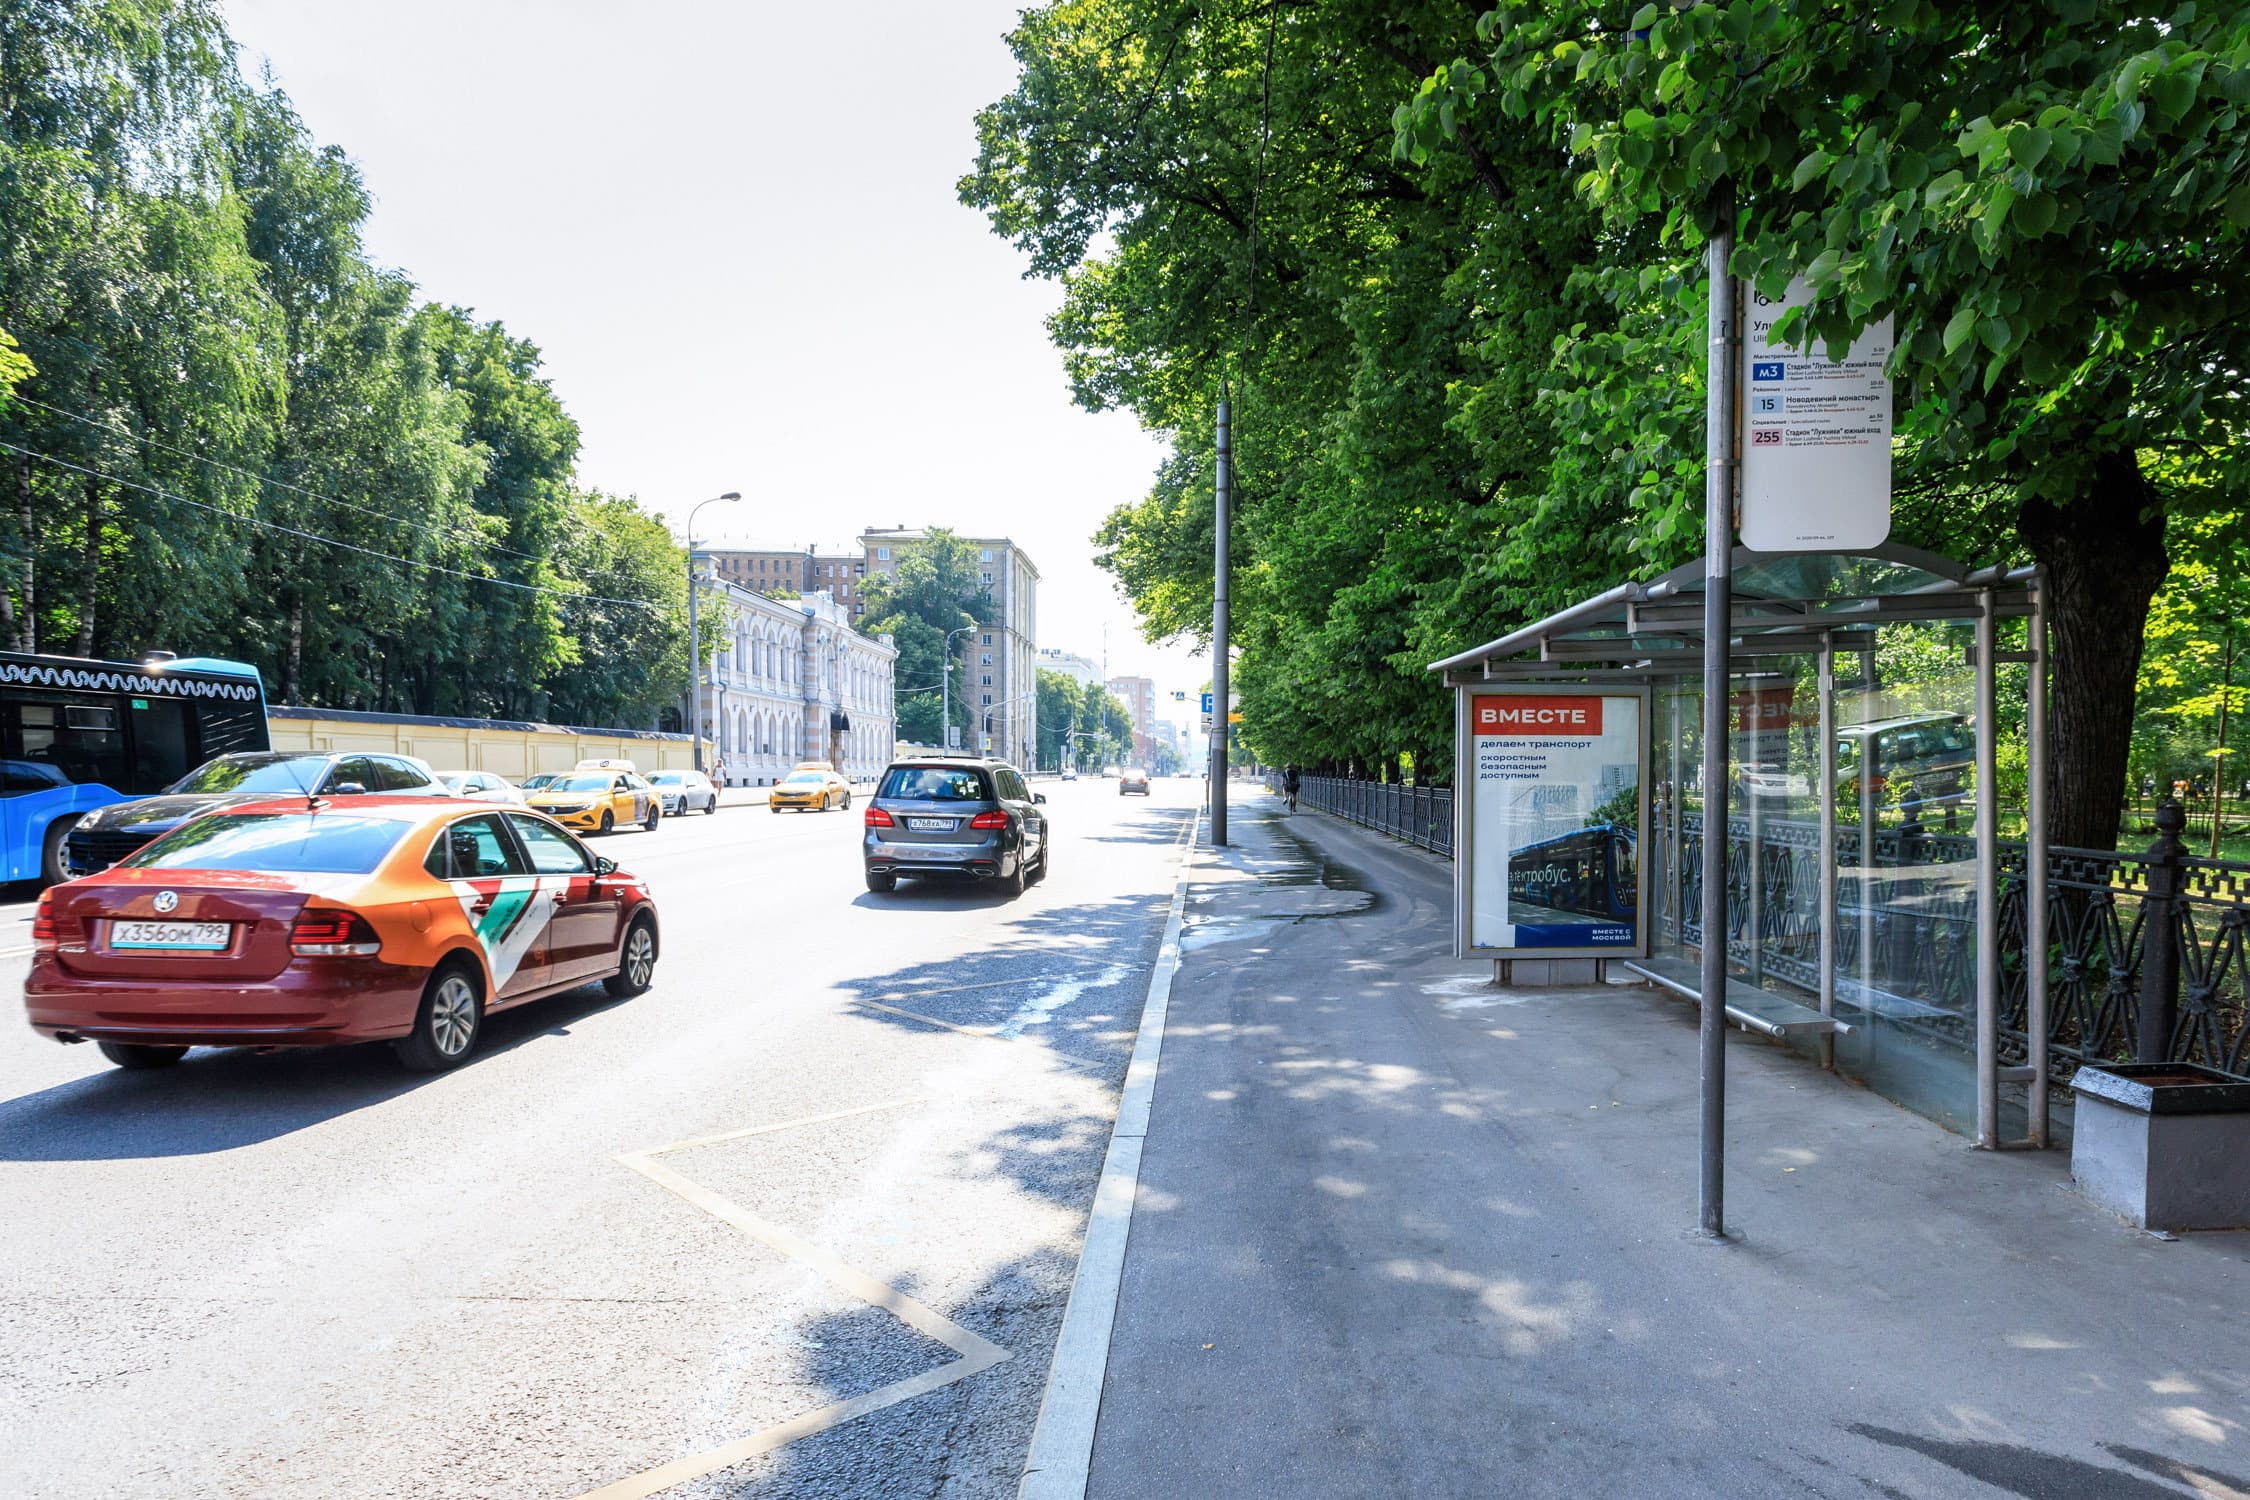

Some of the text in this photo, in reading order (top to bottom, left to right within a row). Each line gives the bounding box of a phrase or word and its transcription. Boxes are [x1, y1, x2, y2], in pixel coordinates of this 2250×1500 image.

[1786, 394, 1880, 404] Новодевичий монастырь
[1761, 399, 1775, 410] 15
[1755, 431, 1780, 443] 255
[1785, 429, 1810, 437] Стадион
[1481, 709, 1586, 723] ВМЕСТЕ
[1481, 741, 1592, 750] делаем транспорт
[1480, 755, 1546, 763] скоростным
[1480, 772, 1540, 780] доступным
[195, 924, 226, 938] 799
